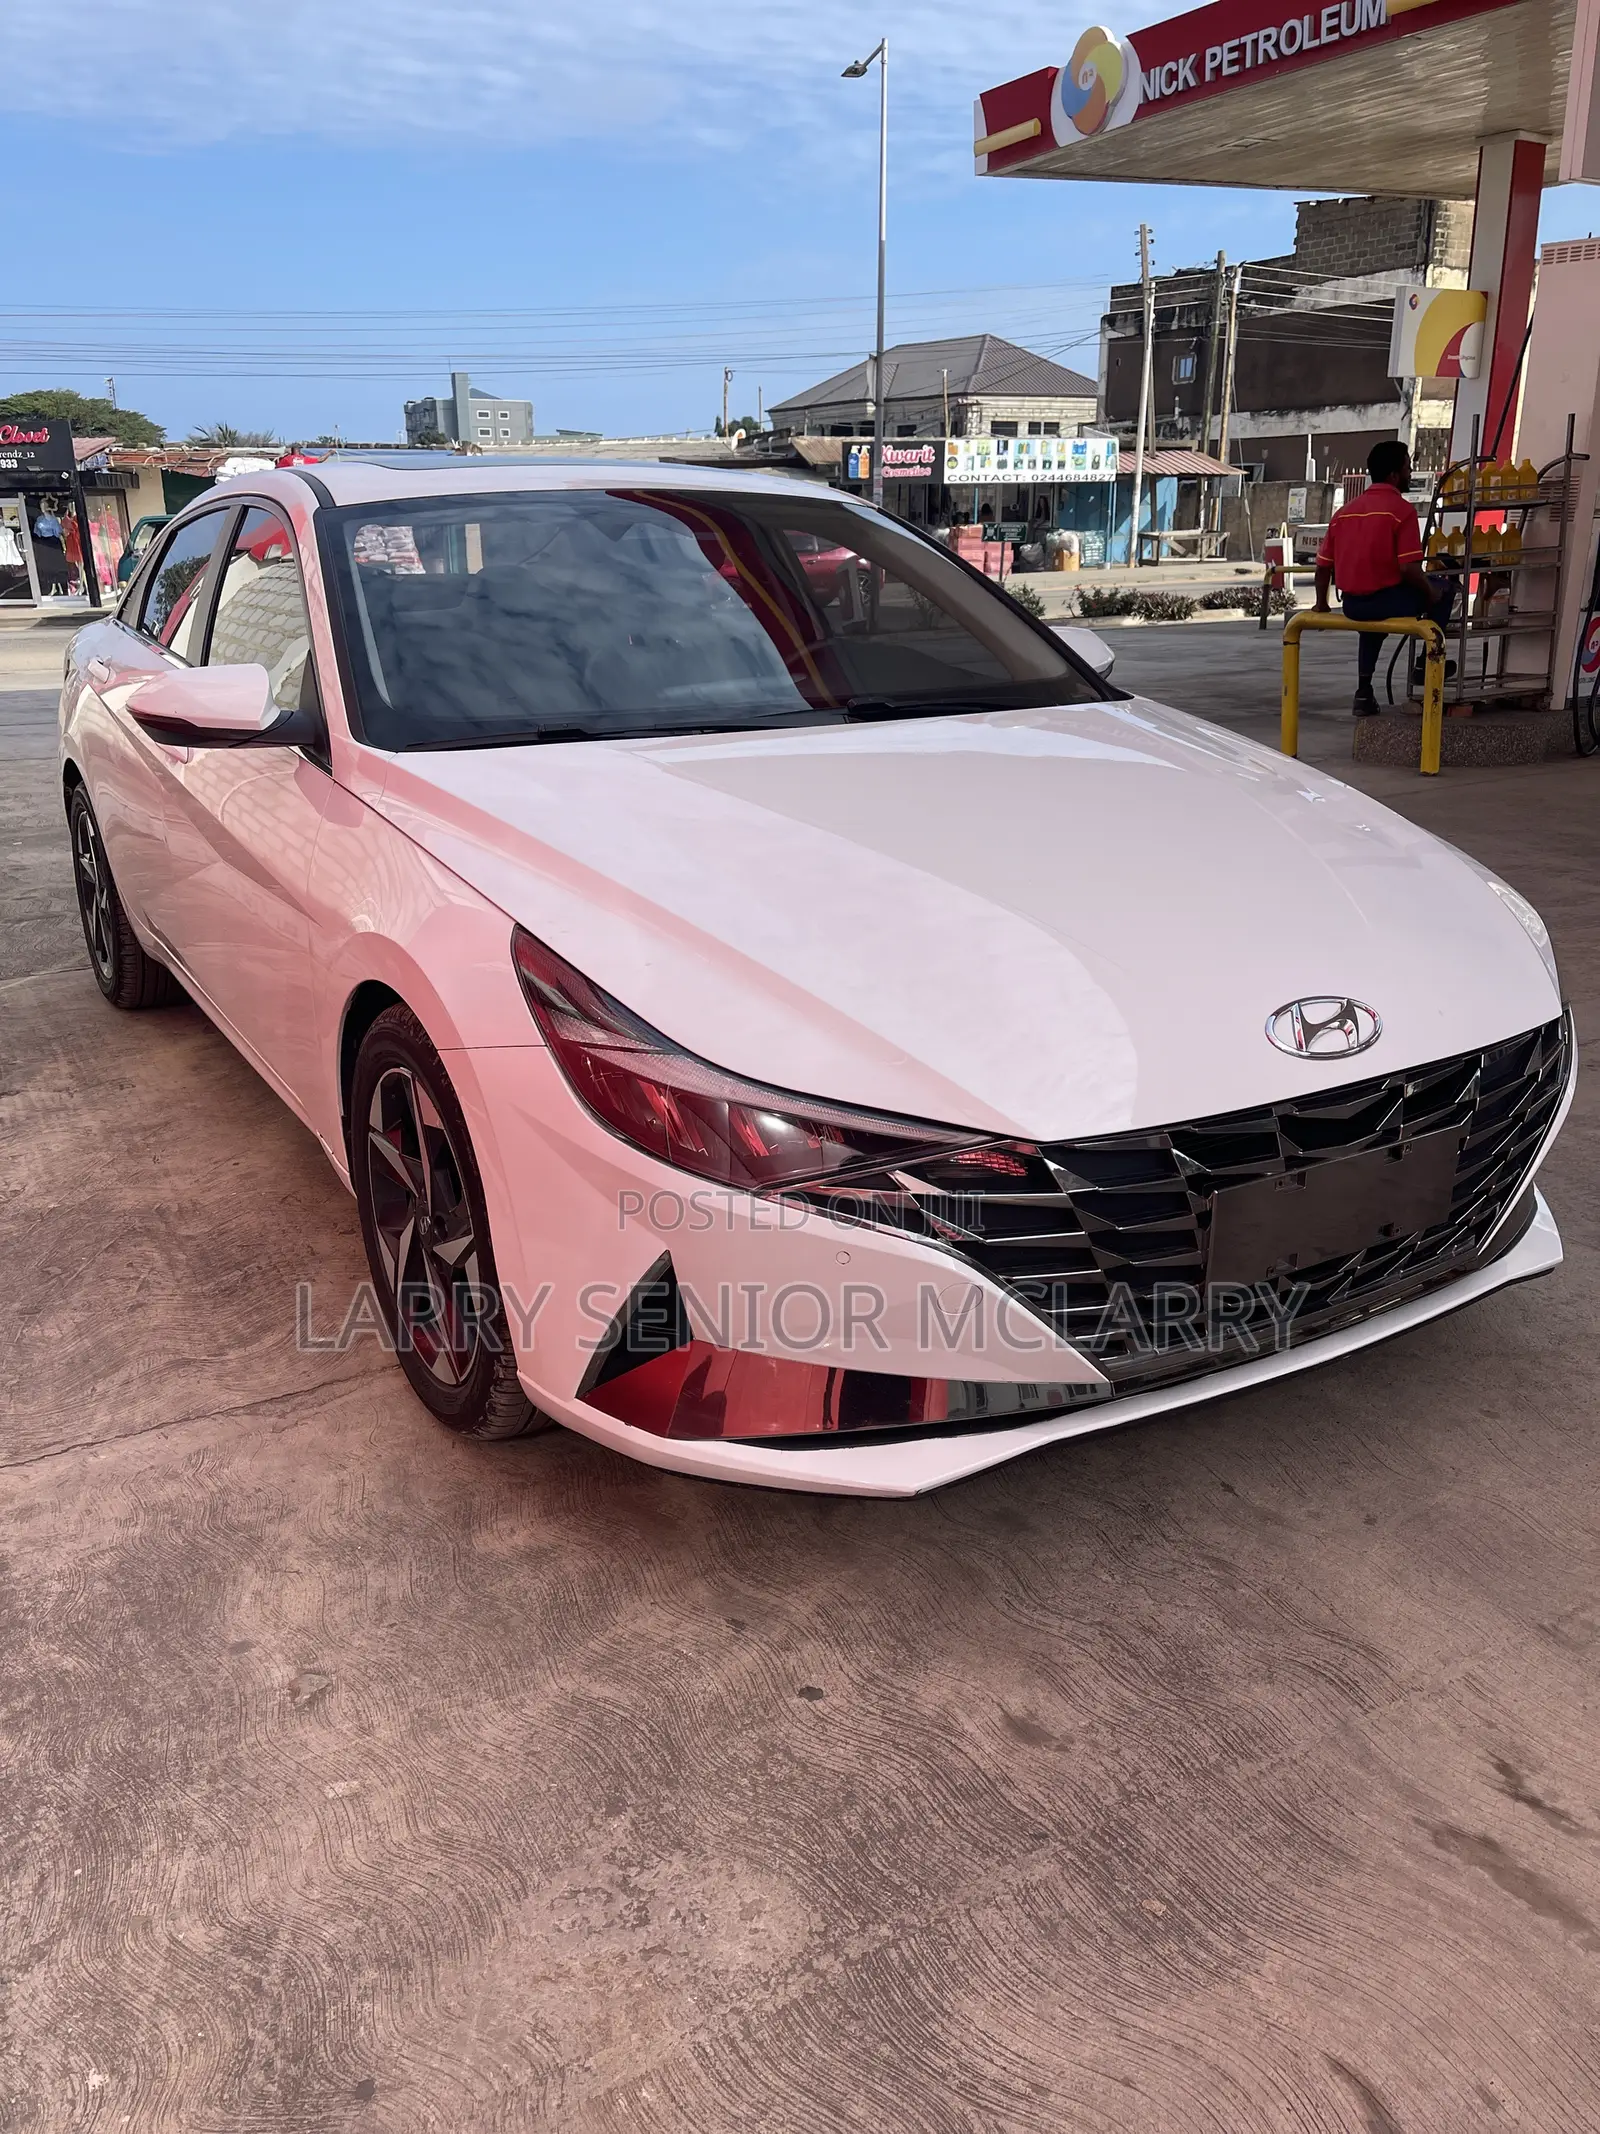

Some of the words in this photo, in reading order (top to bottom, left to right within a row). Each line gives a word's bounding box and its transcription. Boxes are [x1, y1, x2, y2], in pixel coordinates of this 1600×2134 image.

[1139, 53, 1198, 104] NICK
[1204, 0, 1389, 82] PETROLEUM
[0, 425, 50, 444] Closet
[881, 445, 936, 464] Kwarit
[881, 465, 932, 478] Cosmetics
[947, 474, 1026, 482] CONTACT:
[1031, 473, 1114, 482] 0244684827
